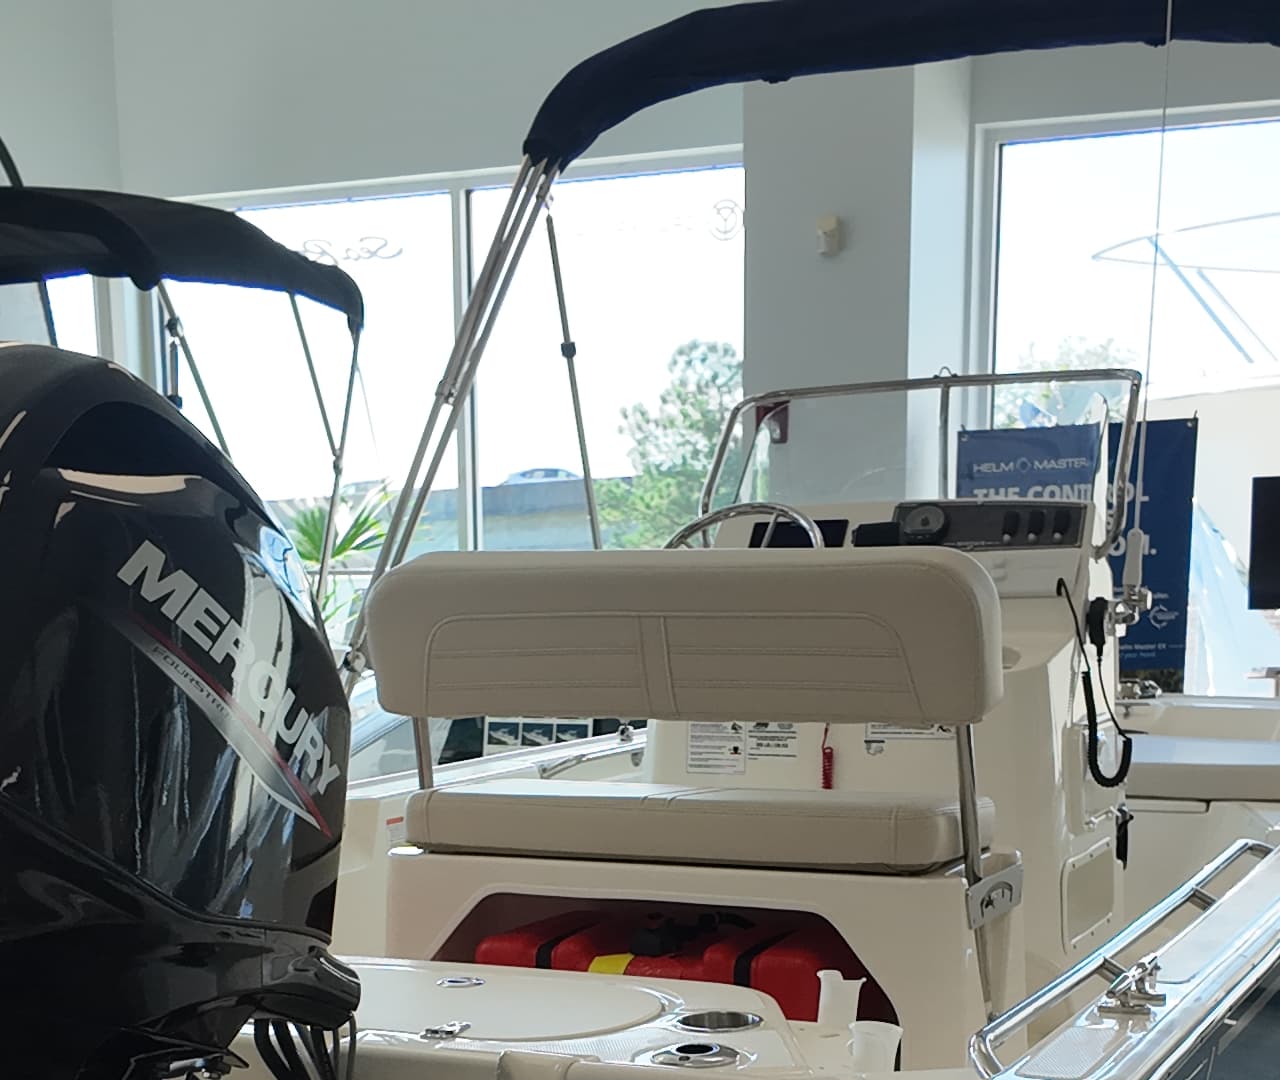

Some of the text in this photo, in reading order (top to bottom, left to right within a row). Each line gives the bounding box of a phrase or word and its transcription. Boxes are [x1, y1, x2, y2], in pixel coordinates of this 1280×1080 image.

[972, 457, 1089, 474] HELM MASTER
[117, 540, 341, 795] MERCURY
